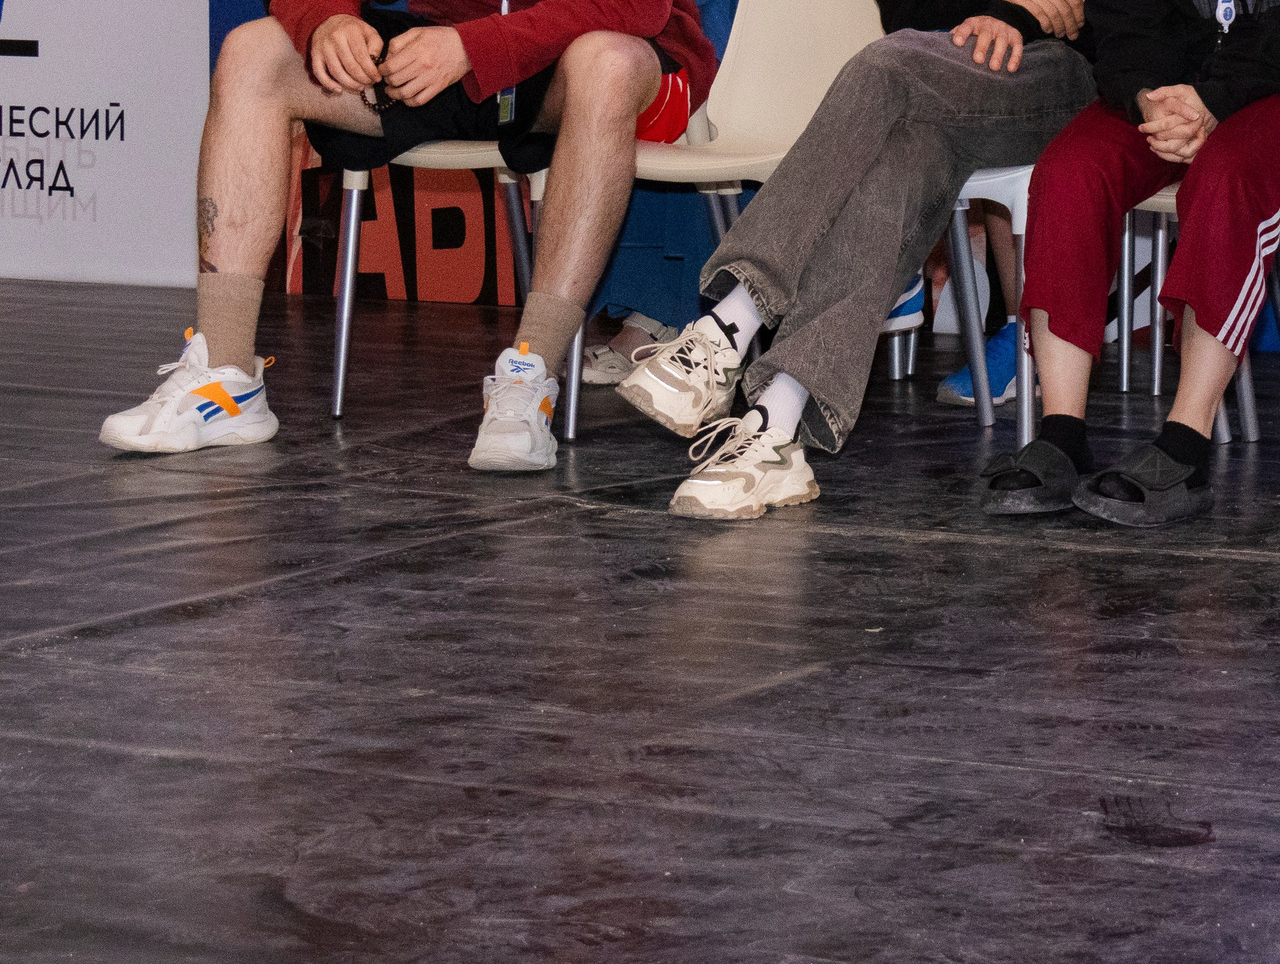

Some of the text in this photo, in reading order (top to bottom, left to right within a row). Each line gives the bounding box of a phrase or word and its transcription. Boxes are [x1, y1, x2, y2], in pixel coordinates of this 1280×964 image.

[0, 102, 125, 142] ЕСКИЙ
[0, 157, 75, 198] ЛЯД
[508, 358, 535, 369] Reebok
